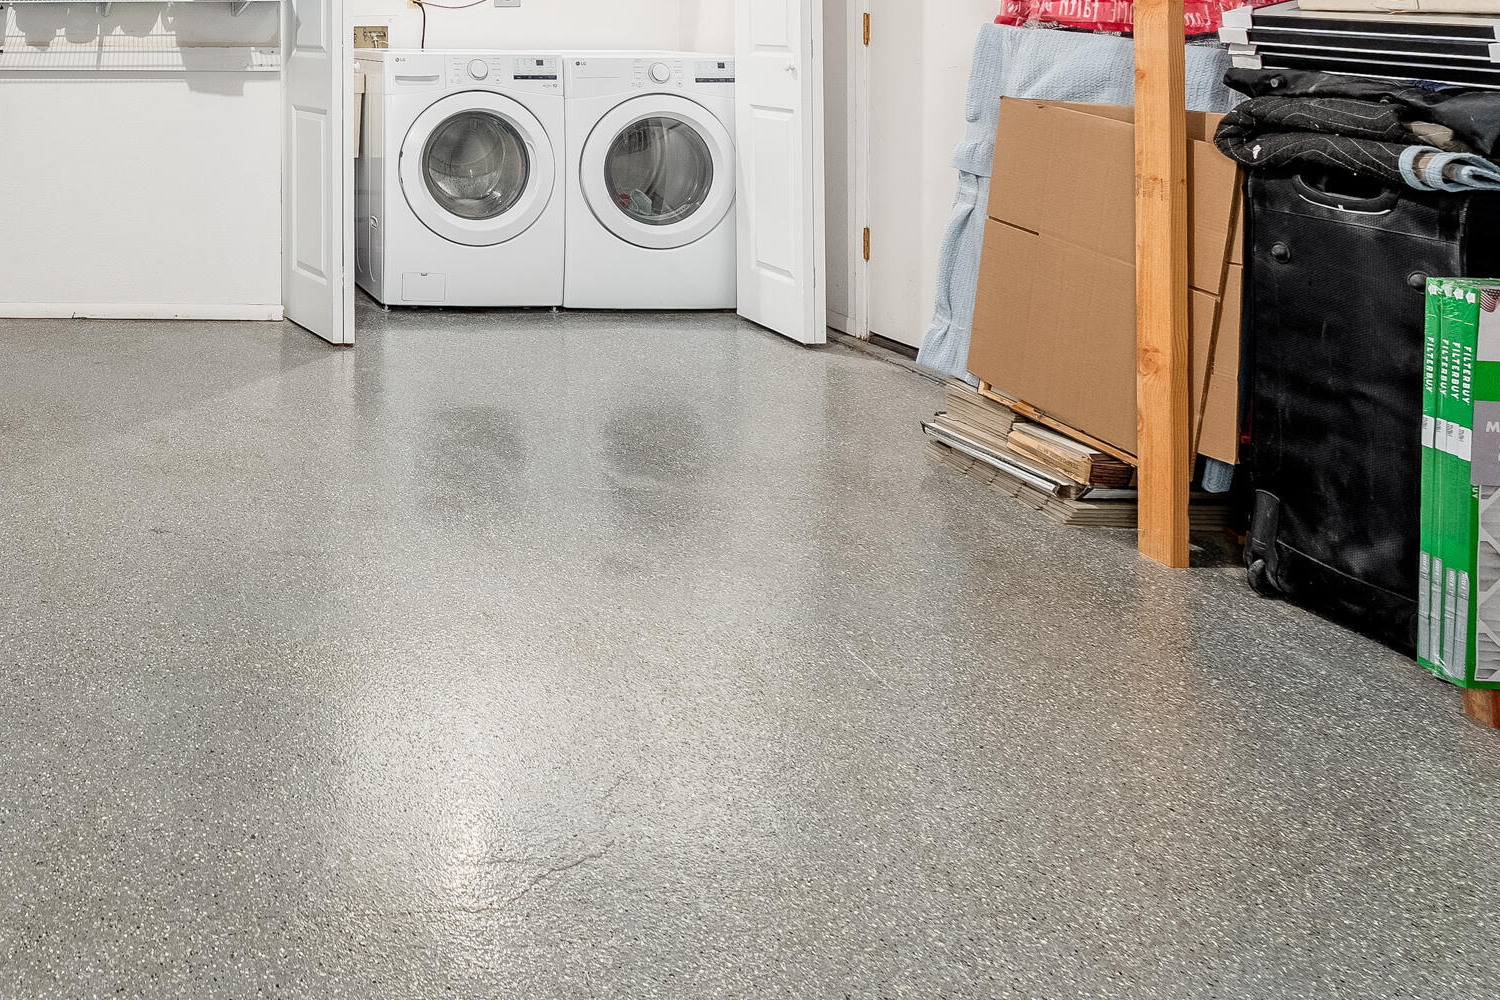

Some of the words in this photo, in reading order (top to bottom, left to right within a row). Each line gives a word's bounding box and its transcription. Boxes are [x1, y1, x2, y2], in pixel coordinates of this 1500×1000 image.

[1426, 337, 1434, 393] FILTERBUY
[1440, 339, 1449, 396] FILTERBUY
[1450, 342, 1460, 400] FILTERBUY
[1462, 345, 1472, 404] FILTERBUY
